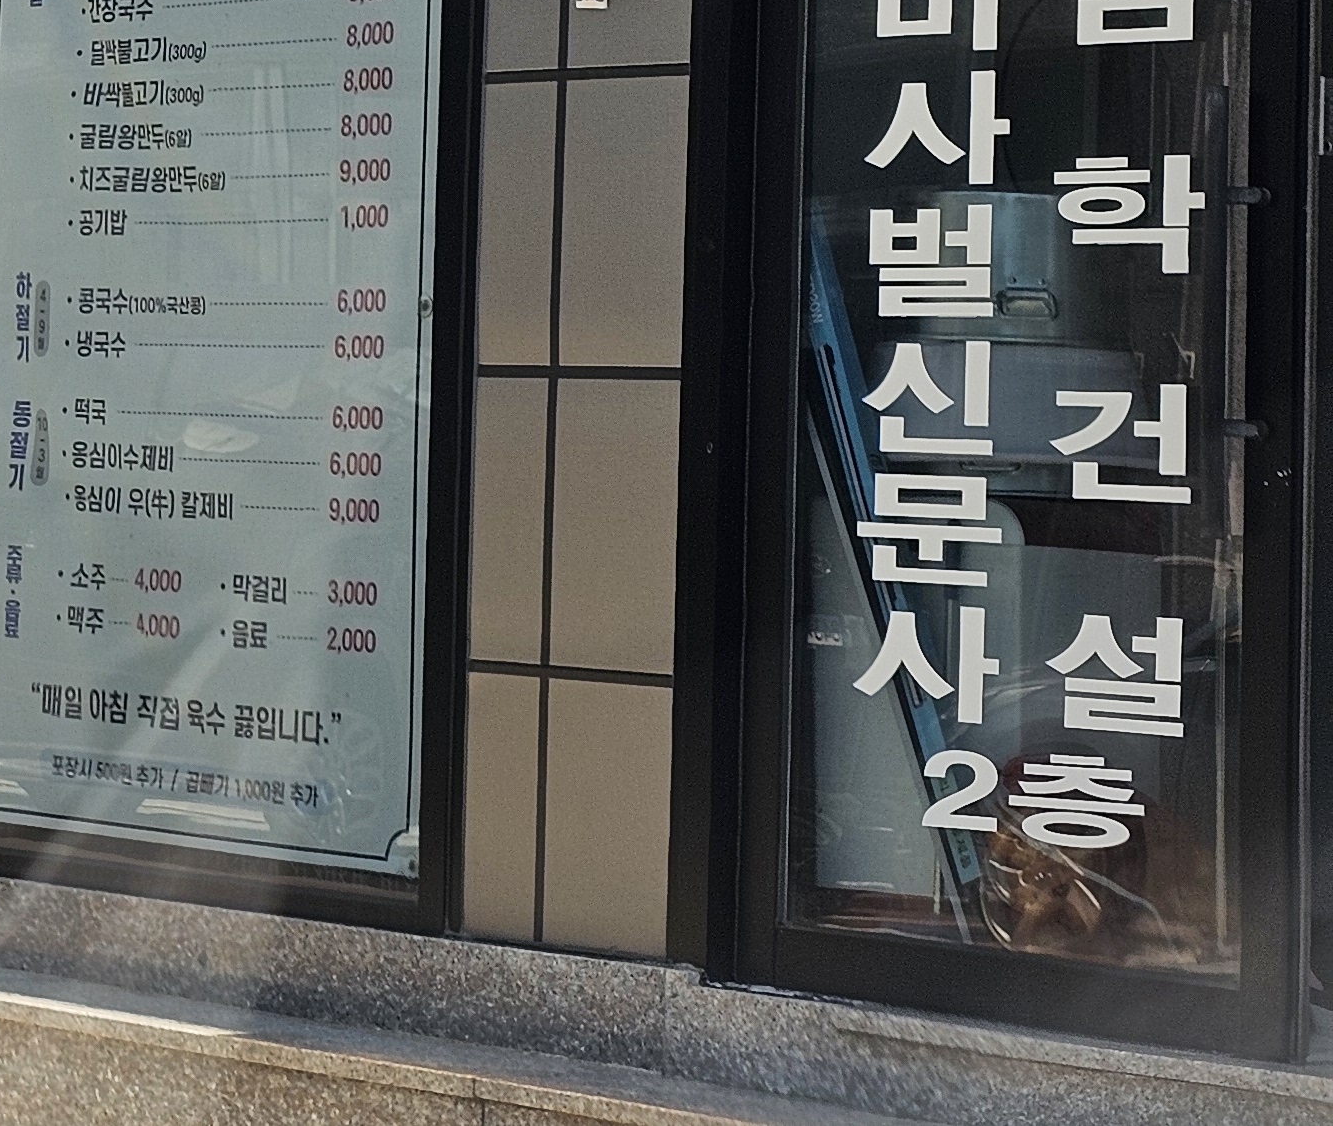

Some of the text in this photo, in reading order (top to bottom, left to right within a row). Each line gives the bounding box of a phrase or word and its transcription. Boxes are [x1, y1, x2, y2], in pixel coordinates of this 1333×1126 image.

[346, 21, 395, 50] 8,000
[83, 66, 394, 108] 바싹불고기(300g) 8,000
[80, 112, 393, 151] 굴림왕만두(6알) 8,000
[79, 158, 391, 193] 치즈굴림왕만두(6알) 9,000
[79, 203, 389, 236] 공기밥 1,000
[15, 271, 32, 363] 하절기
[78, 288, 387, 316] 콩국수(100%국산콩) 6,000
[77, 331, 385, 360] 냉국수 6,000
[74, 398, 384, 432] 떡국 6,000
[8, 400, 31, 491] 동절기
[71, 441, 382, 479] 옹심이수제비 6,000
[73, 484, 121, 516] 옹심이
[180, 491, 234, 521] 칼제비
[328, 497, 381, 526] 9,000
[70, 563, 378, 606] 소주 4,000 막걸리 3,000
[66, 606, 377, 655] 맥주 4,000 음료 2,000
[89, 688, 129, 724] 아침
[136, 694, 181, 731] 직접
[186, 699, 226, 736] 육수
[52, 754, 92, 780] 포장시
[135, 765, 164, 790] 추가
[290, 781, 320, 809] 추가
[921, 748, 1145, 849] 2층
